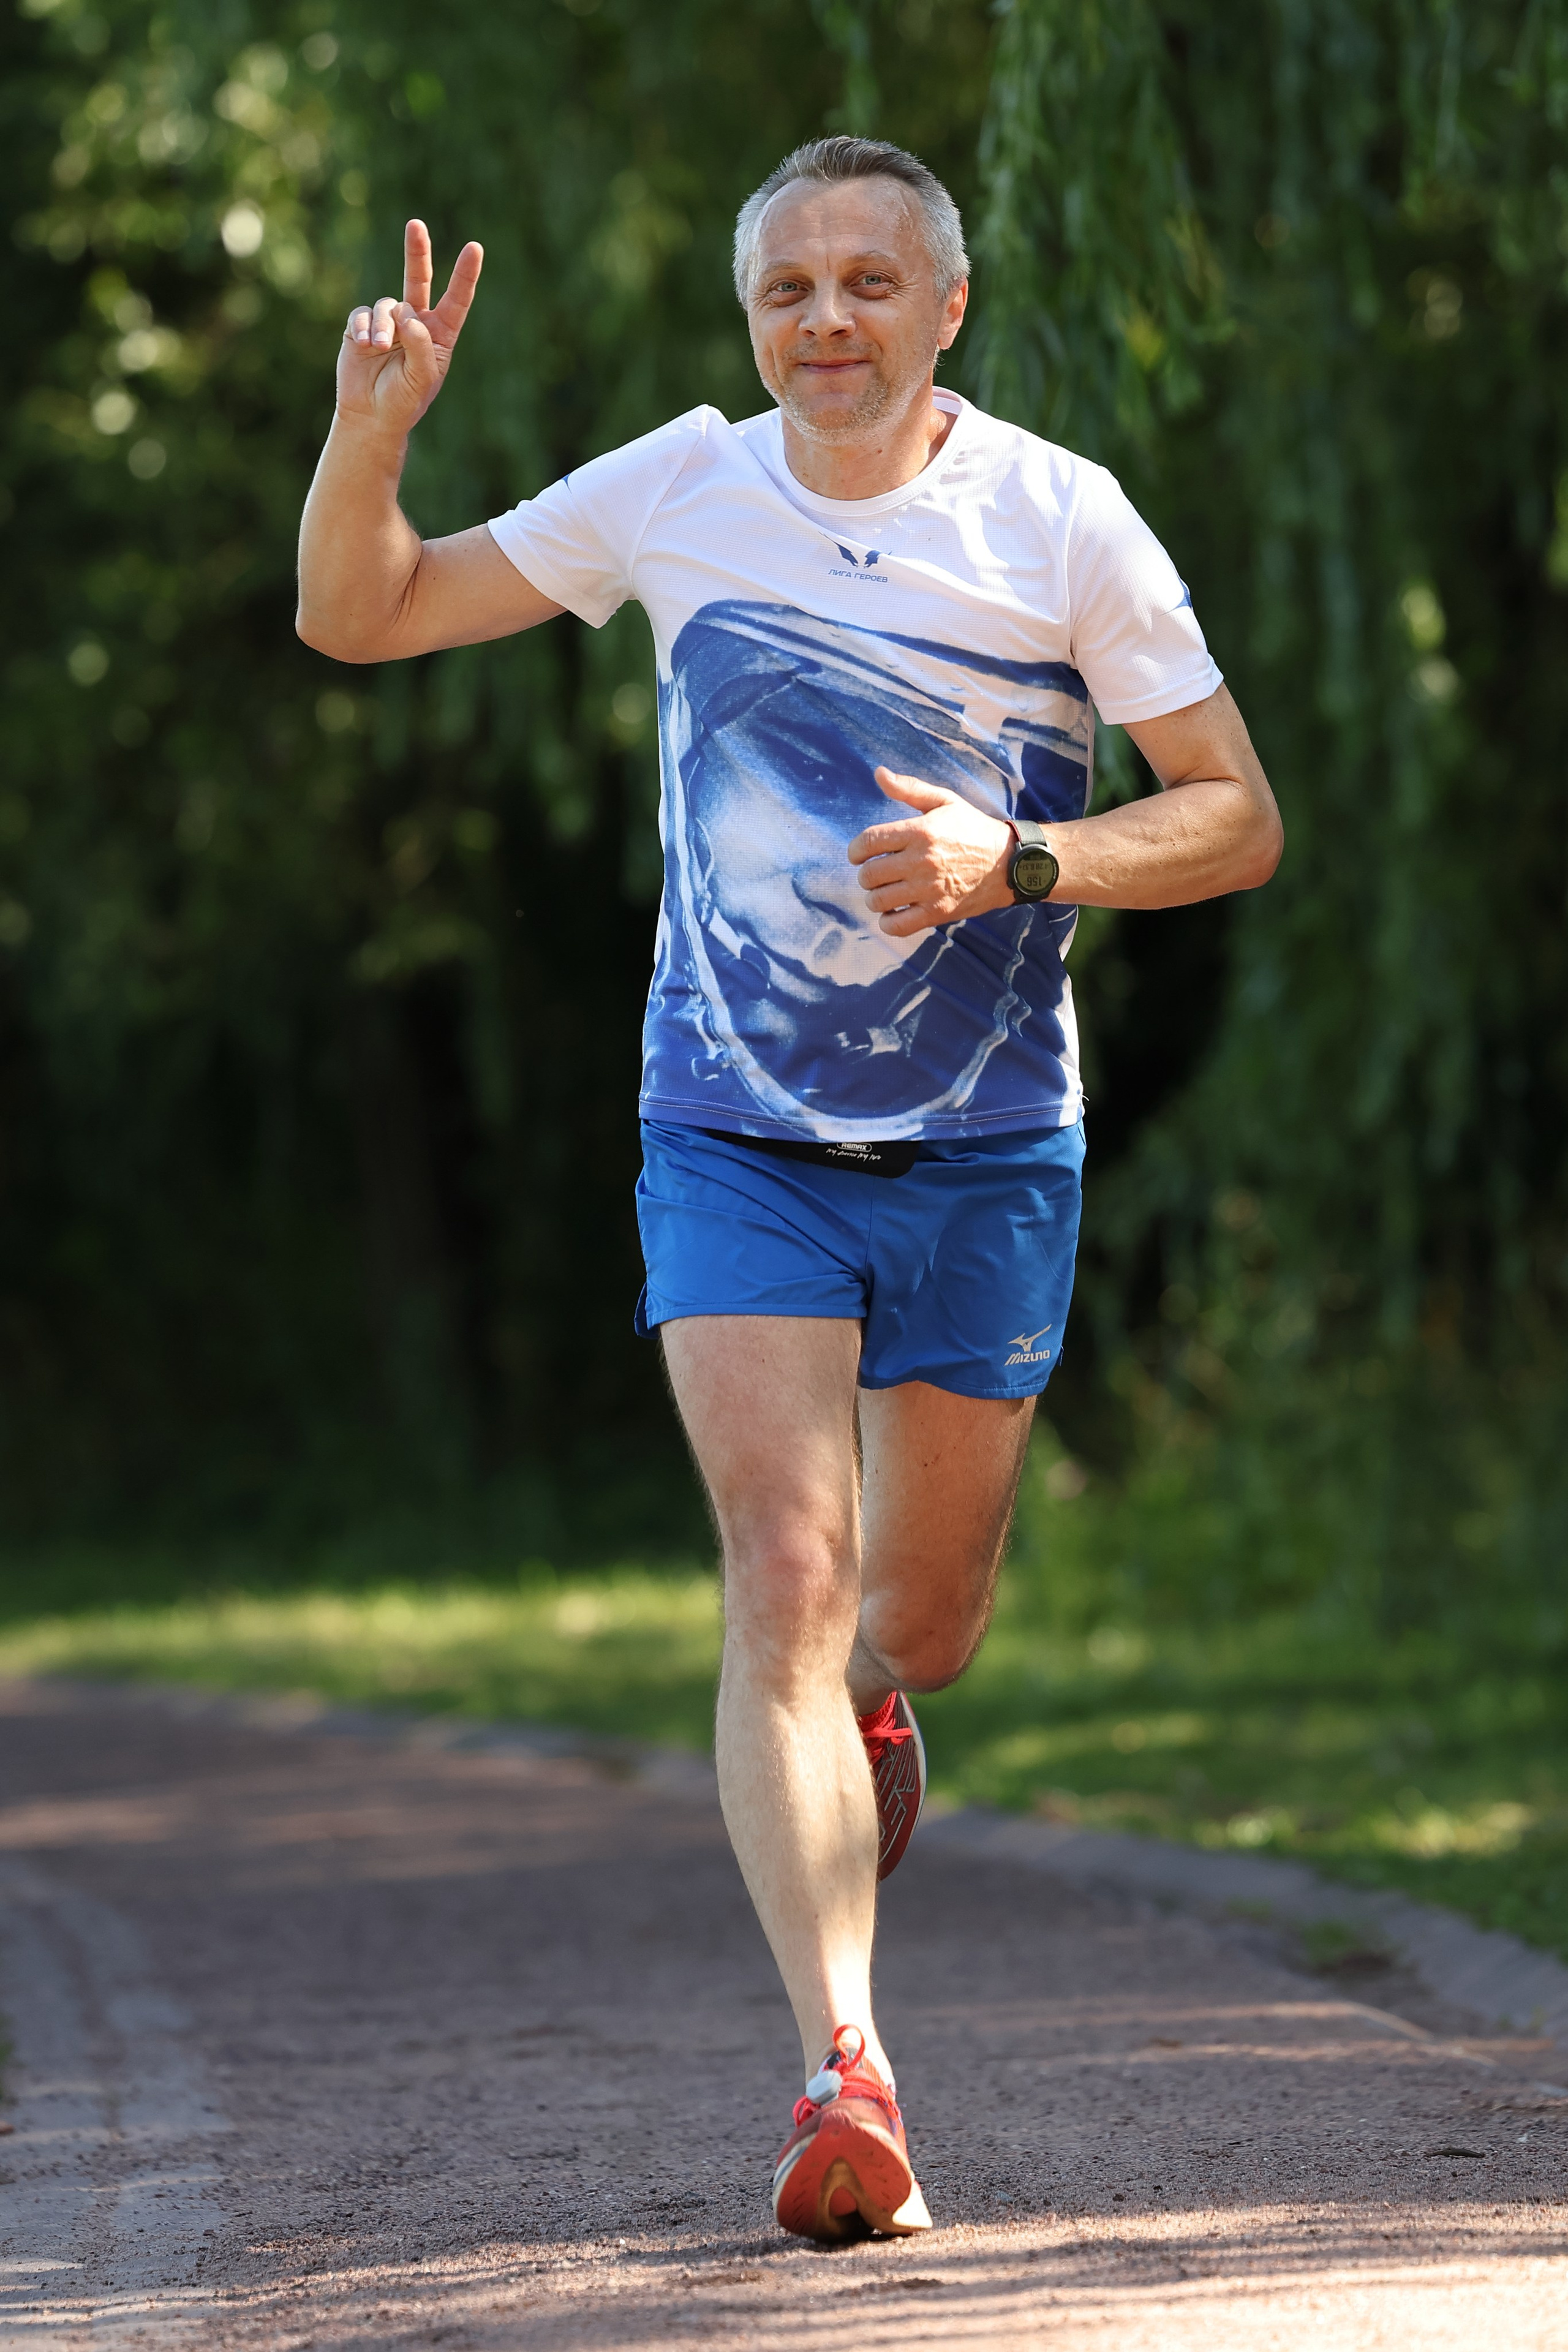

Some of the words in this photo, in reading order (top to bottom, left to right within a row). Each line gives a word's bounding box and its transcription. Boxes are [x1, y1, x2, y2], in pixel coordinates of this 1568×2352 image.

[828, 569, 851, 578] ЛИГА
[854, 573, 888, 582] ГЕРОЕВ
[1027, 876, 1042, 887] 156
[1005, 1349, 1050, 1366] MIZUNO
